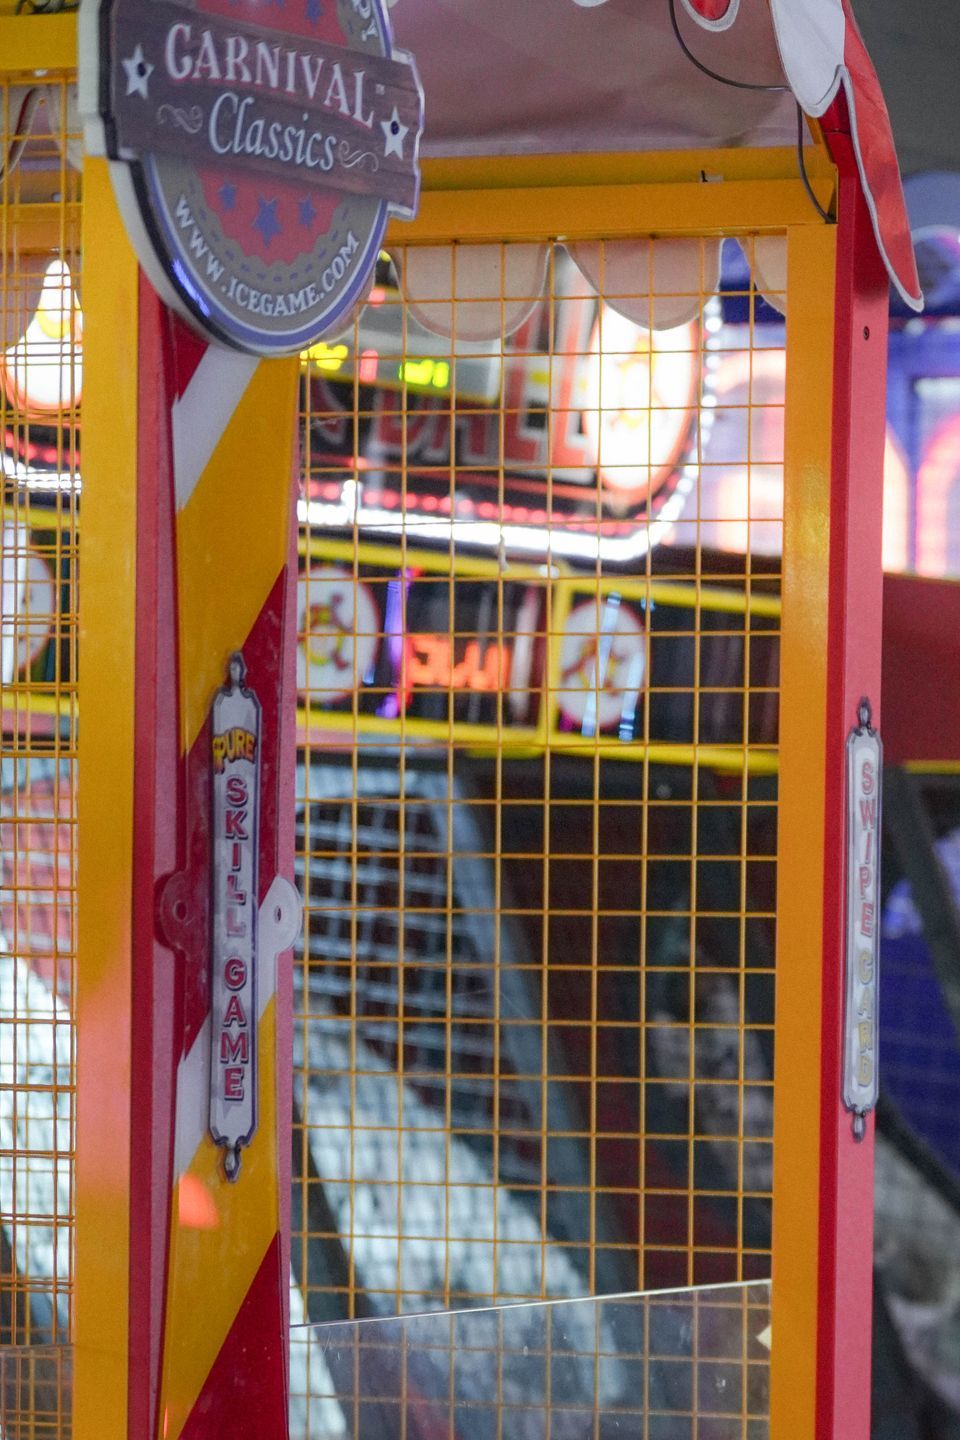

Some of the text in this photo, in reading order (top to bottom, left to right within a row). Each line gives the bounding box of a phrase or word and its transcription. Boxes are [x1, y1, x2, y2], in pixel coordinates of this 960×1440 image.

[165, 23, 376, 129] CARNIVAL
[208, 92, 337, 172] Classics
[175, 194, 360, 317] WWW.ICEGAME.COM
[213, 728, 256, 772] PURE
[857, 760, 877, 939] SWIPE
[220, 775, 249, 1101] SKILL GAME
